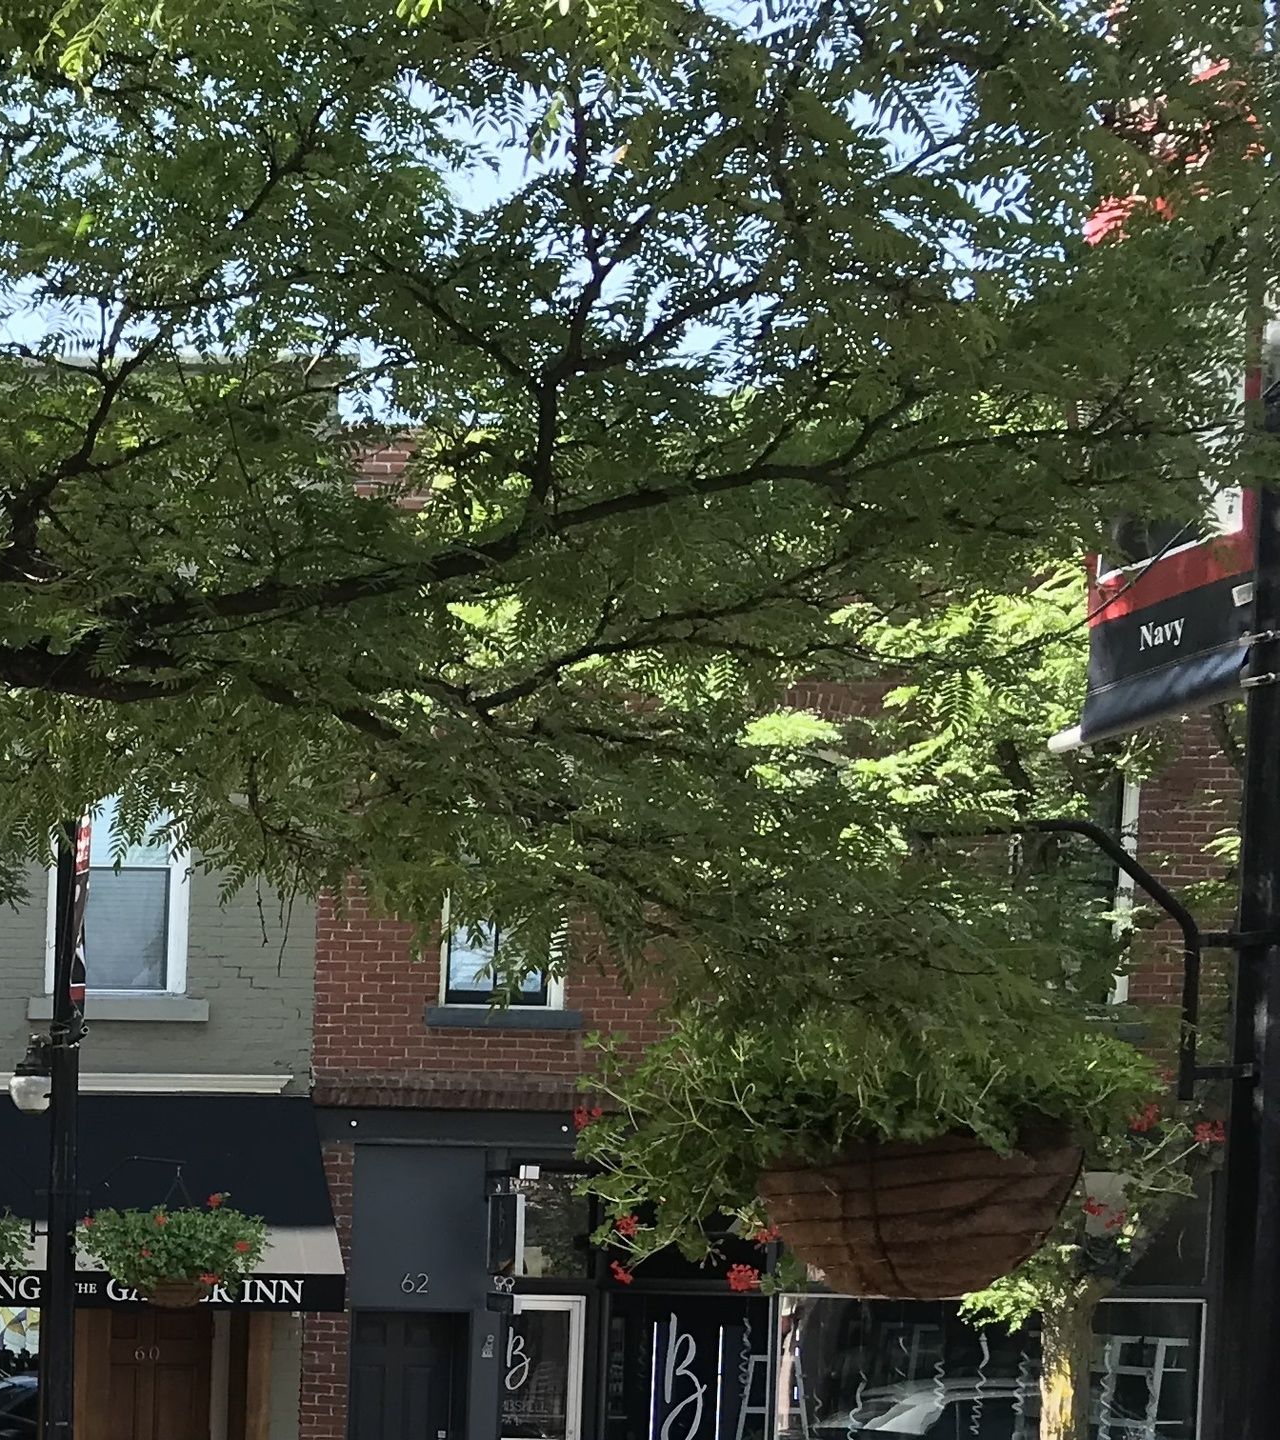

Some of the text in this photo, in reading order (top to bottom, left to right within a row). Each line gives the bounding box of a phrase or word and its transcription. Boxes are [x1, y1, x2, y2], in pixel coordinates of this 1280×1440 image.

[1140, 618, 1185, 651] Navy
[75, 1282, 98, 1295] HE
[240, 1279, 304, 1304] INN
[400, 1273, 429, 1295] 62
[134, 1346, 161, 1361] 60
